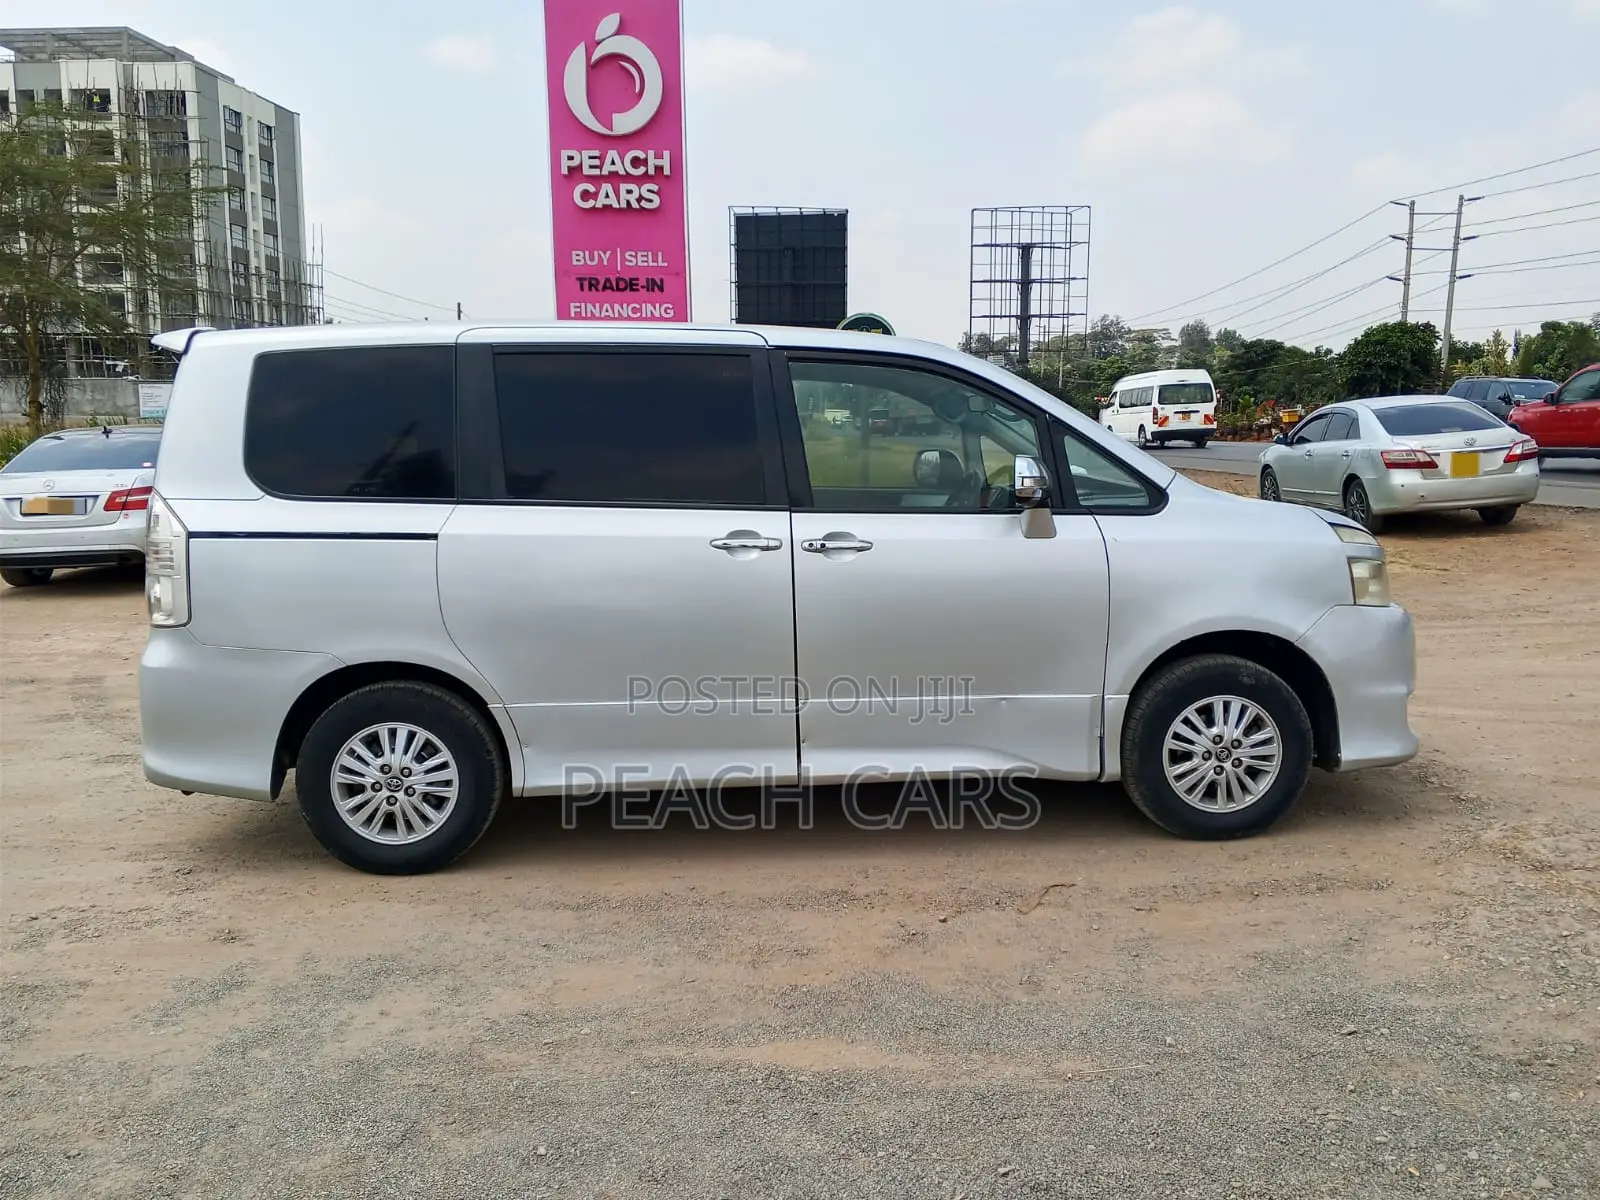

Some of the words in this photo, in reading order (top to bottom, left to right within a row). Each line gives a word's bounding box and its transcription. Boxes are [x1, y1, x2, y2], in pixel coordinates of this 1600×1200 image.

[560, 149, 672, 177] PEACH
[572, 182, 661, 210] CARS
[571, 250, 612, 266] BUY
[624, 251, 669, 267] SELL
[575, 276, 665, 293] TRADE-IN
[569, 302, 675, 319] FINANCING
